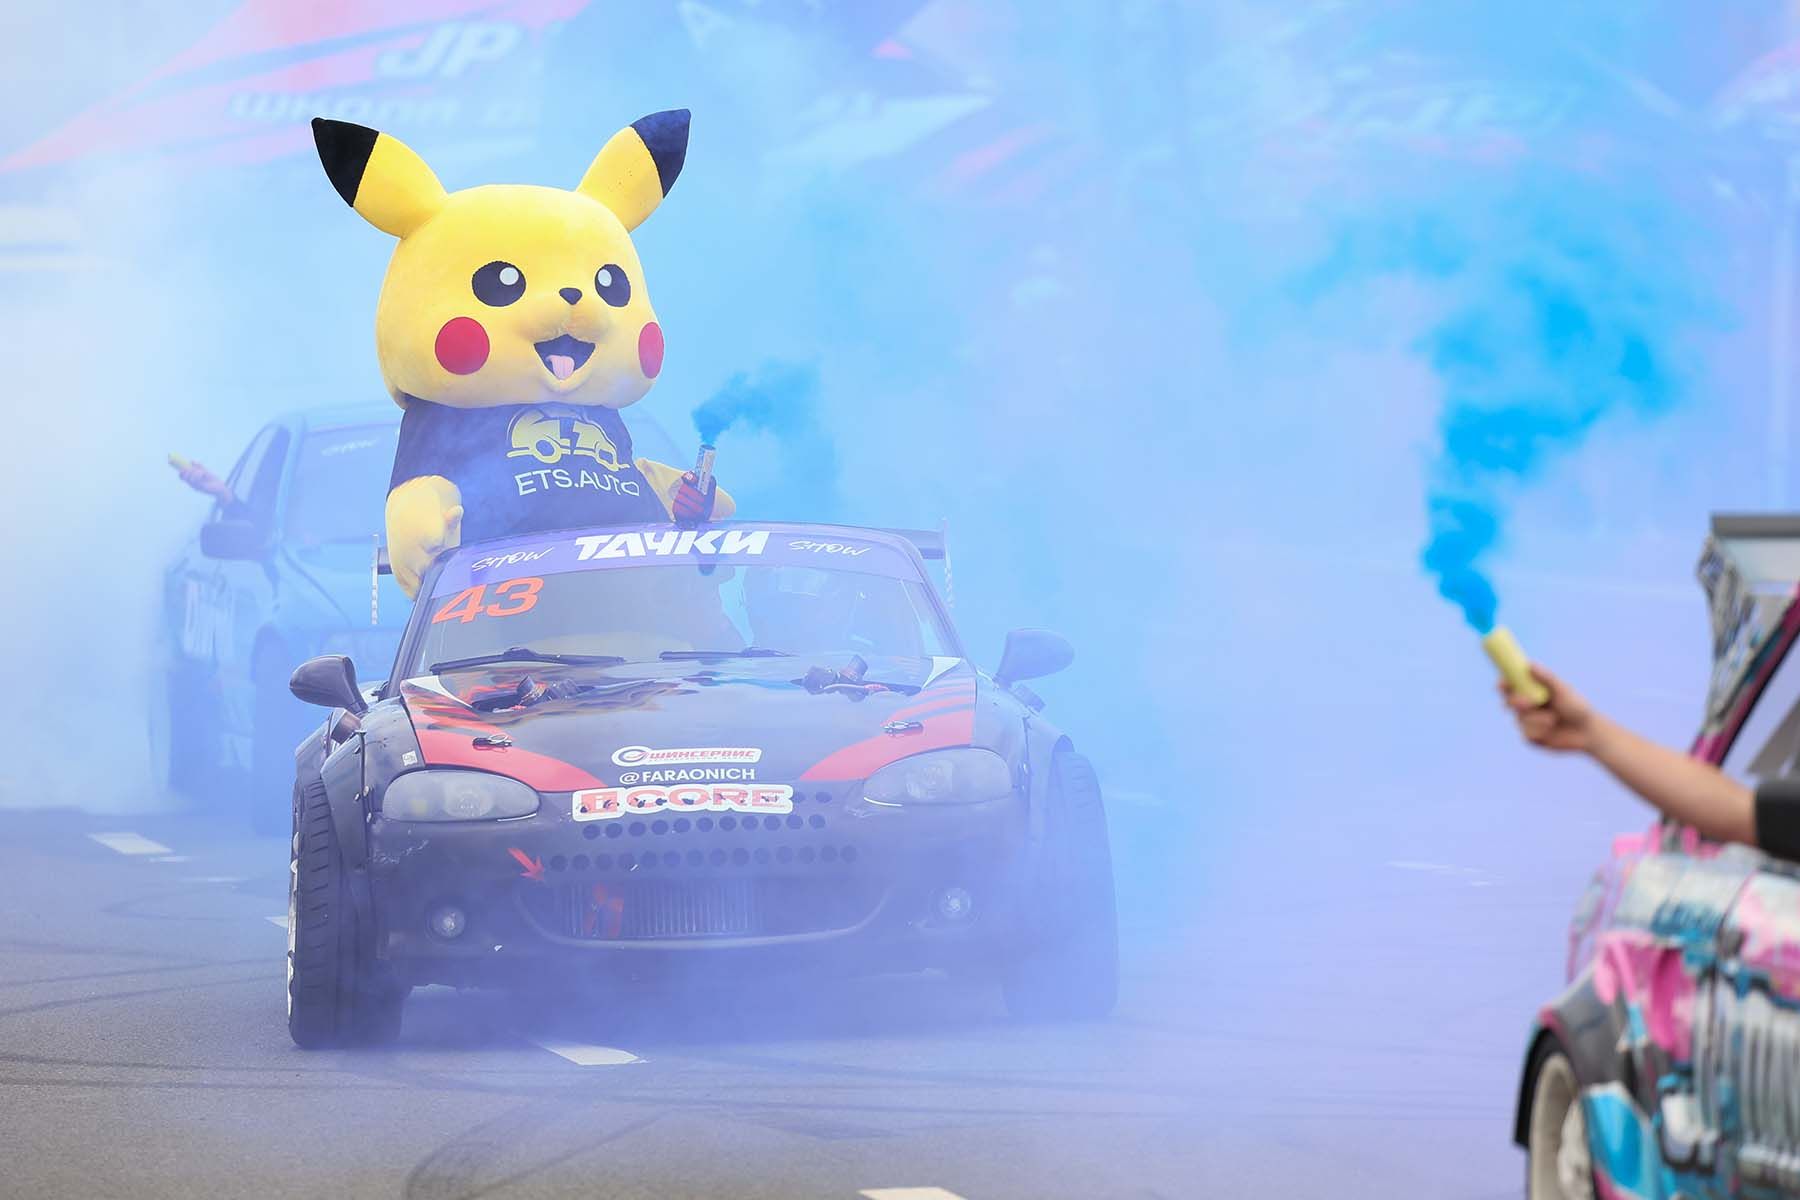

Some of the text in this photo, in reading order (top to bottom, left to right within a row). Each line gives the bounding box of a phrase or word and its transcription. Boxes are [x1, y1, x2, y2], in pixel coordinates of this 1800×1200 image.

[376, 20, 525, 78] JP
[514, 469, 640, 497] ETS.AUTO
[471, 530, 872, 572] SHOW ТАЧКИ SHOW
[431, 576, 544, 624] 43
[649, 750, 754, 760] ШИНСЕРВИС
[619, 768, 755, 784] @FARAONICH
